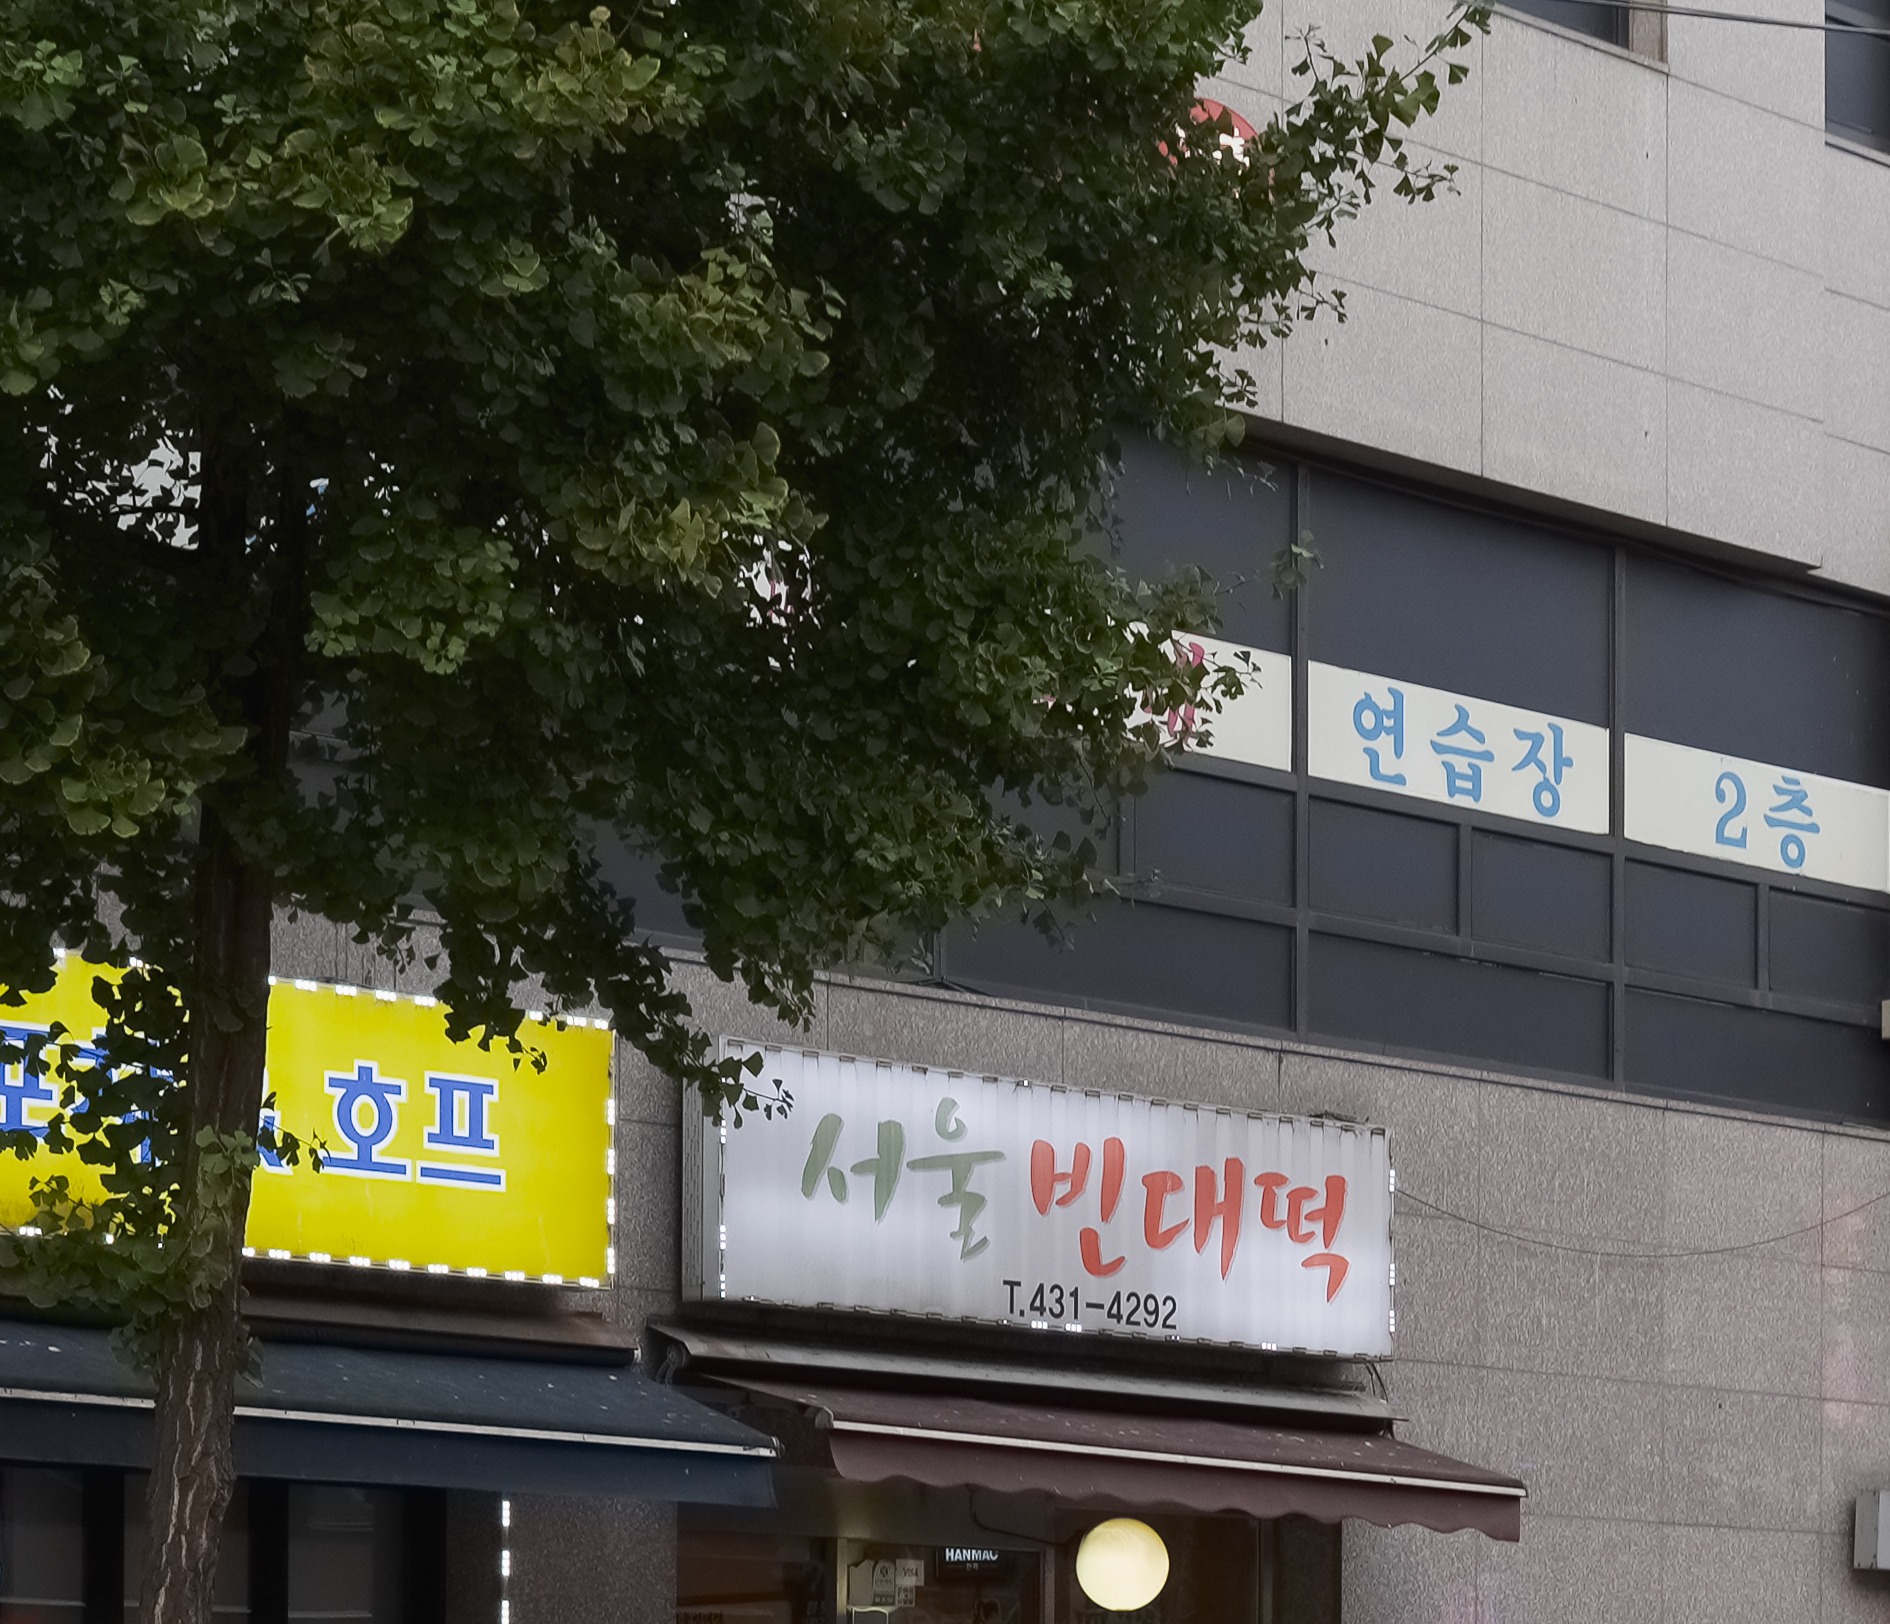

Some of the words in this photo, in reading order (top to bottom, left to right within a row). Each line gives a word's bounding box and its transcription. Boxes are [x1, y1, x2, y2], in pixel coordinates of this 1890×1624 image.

[1352, 686, 1575, 819] 연습장
[1715, 770, 1820, 869] 2층
[323, 1059, 506, 1193] 호프
[800, 1098, 1006, 1262] 서울
[1029, 1137, 1347, 1304] 빈대떡
[1002, 1279, 1177, 1330] T.431-4292
